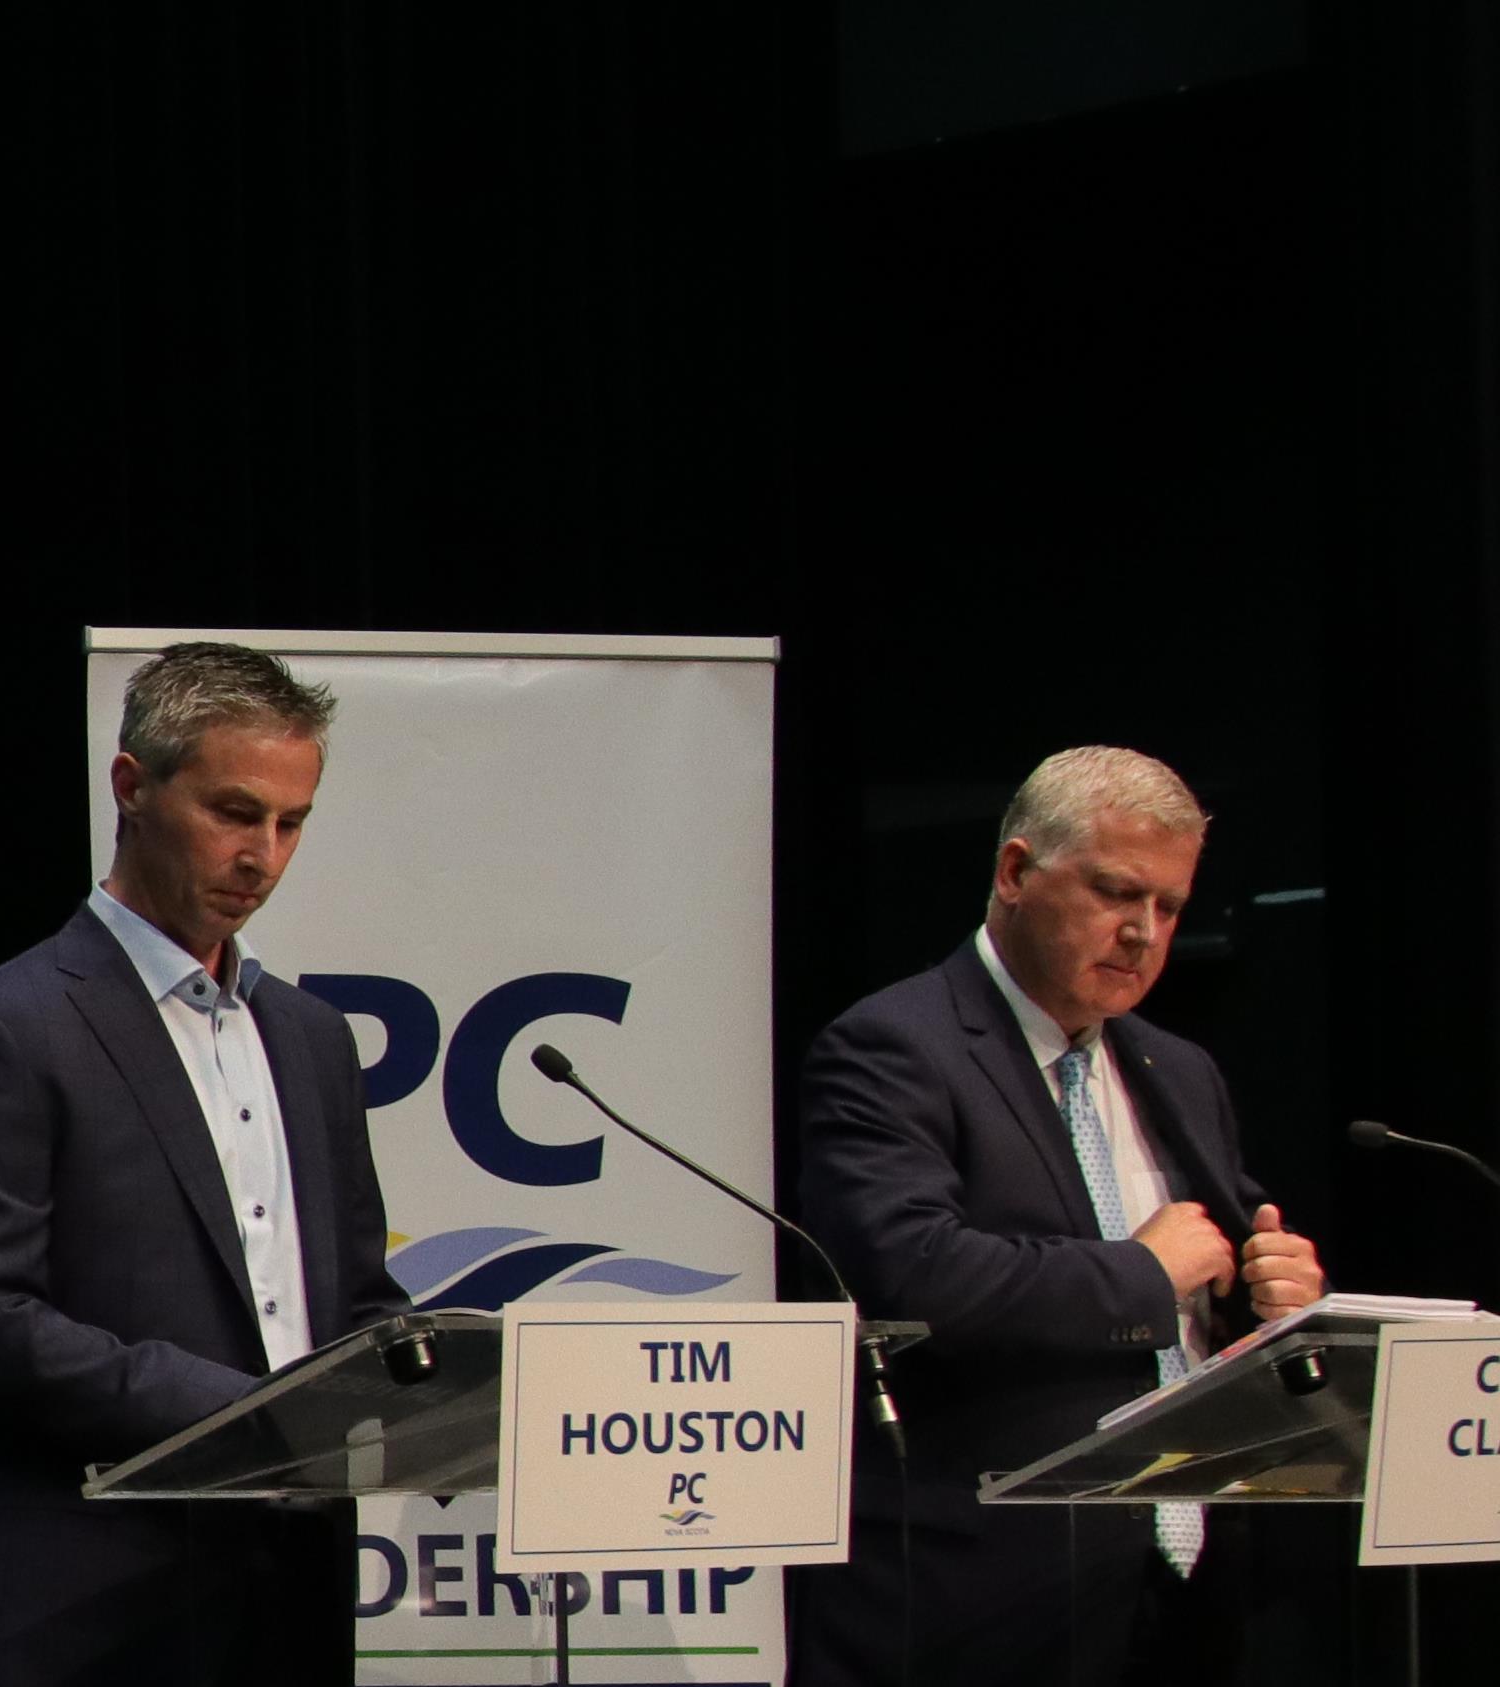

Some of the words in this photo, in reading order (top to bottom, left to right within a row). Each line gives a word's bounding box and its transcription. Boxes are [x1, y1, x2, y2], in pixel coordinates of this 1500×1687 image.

[297, 972, 632, 1187] PC
[639, 1340, 732, 1384] TIM
[561, 1409, 805, 1457] HOUSTON
[1447, 1417, 1500, 1458] CL
[668, 1472, 707, 1505] PC
